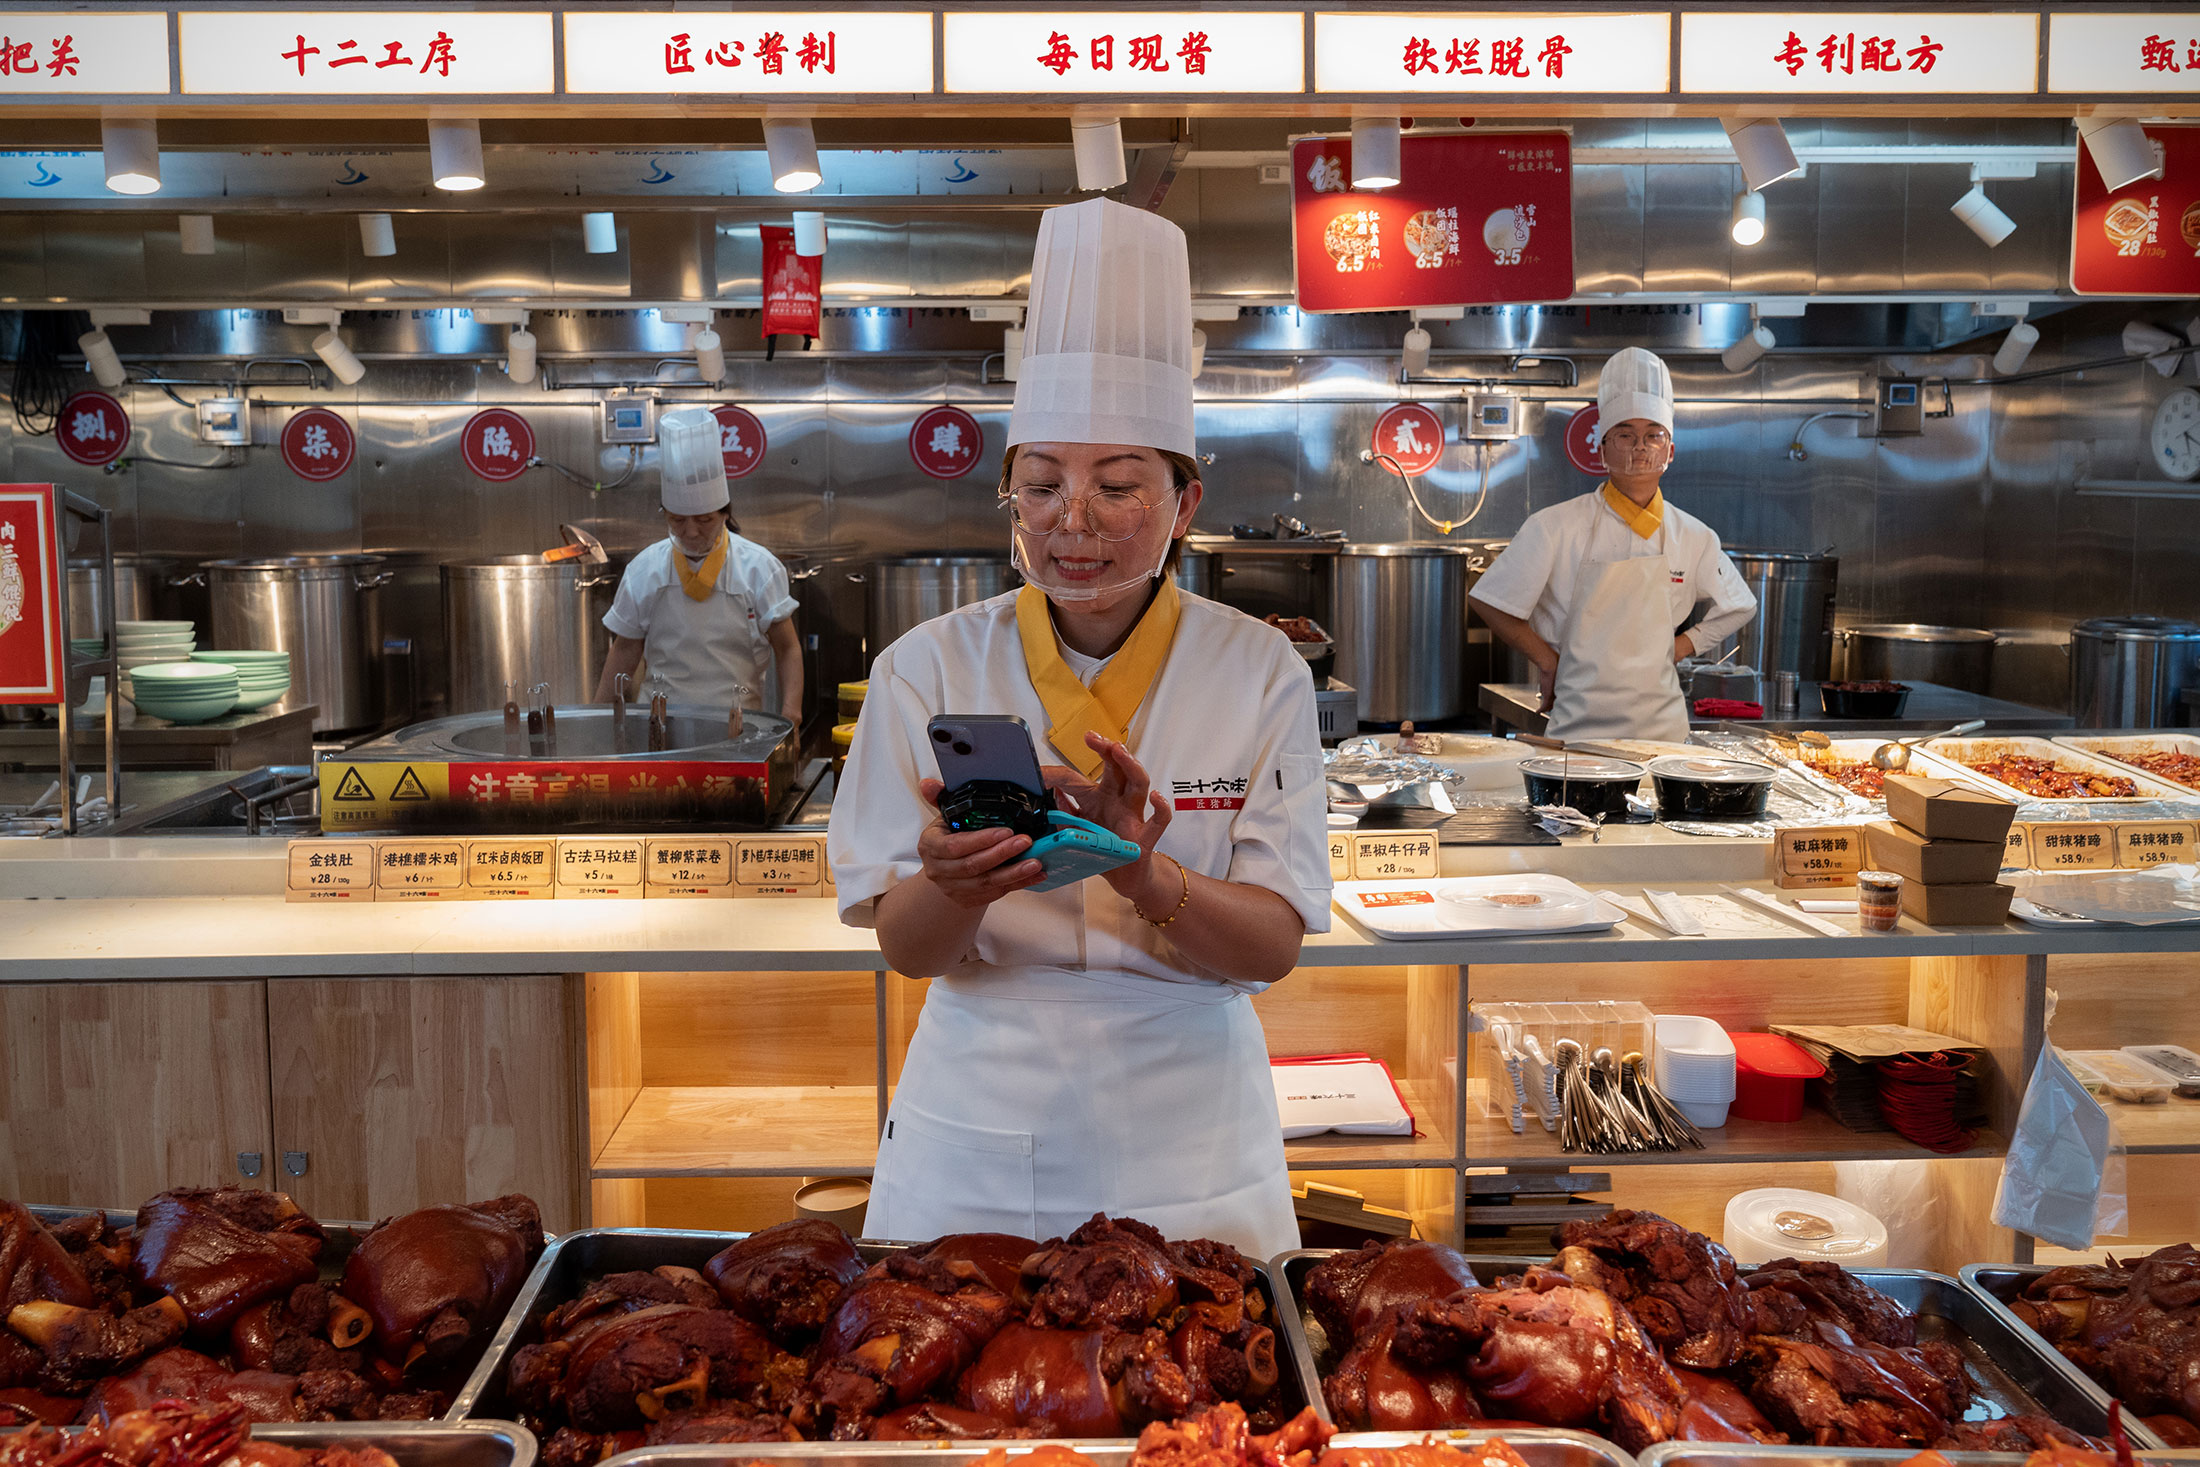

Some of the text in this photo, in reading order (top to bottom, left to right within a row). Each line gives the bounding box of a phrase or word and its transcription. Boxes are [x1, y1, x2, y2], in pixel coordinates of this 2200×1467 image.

[0, 34, 80, 78] 把关
[281, 31, 457, 77] 十二工序
[664, 30, 837, 76] 匠心酱制
[1036, 30, 1213, 76] 每日现酱
[1401, 33, 1574, 79] 软烂脱骨
[1772, 31, 1945, 77] 专利配方
[1356, 210, 1368, 235] 饭团
[1435, 207, 1447, 231] 饭团
[1526, 203, 1537, 227] 雪山
[1447, 207, 1460, 256] 瑶柱海鲜
[1494, 247, 1522, 266] 3.5
[2117, 240, 2141, 256] 28
[1336, 254, 1364, 273] 6.5
[1415, 251, 1443, 269] 6.5
[301, 424, 340, 460] 柒号
[482, 426, 520, 462] 陆号
[928, 421, 971, 458] 肆号
[1392, 418, 1433, 455] 贰号
[1172, 777, 1248, 794] 三十六味
[1793, 838, 1848, 854] 椒麻猪蹄
[2045, 833, 2101, 848] 甜辣猪蹄
[2128, 831, 2184, 847] 麻辣猪蹄
[309, 852, 353, 868] 金钱肚
[476, 850, 544, 865] 红米卤肉饭团
[564, 849, 638, 864] 古法马拉糕
[657, 849, 721, 865] 蟹柳紫菜卷
[1331, 844, 1344, 858] 包
[1359, 842, 1431, 858] 黑椒牛仔骨
